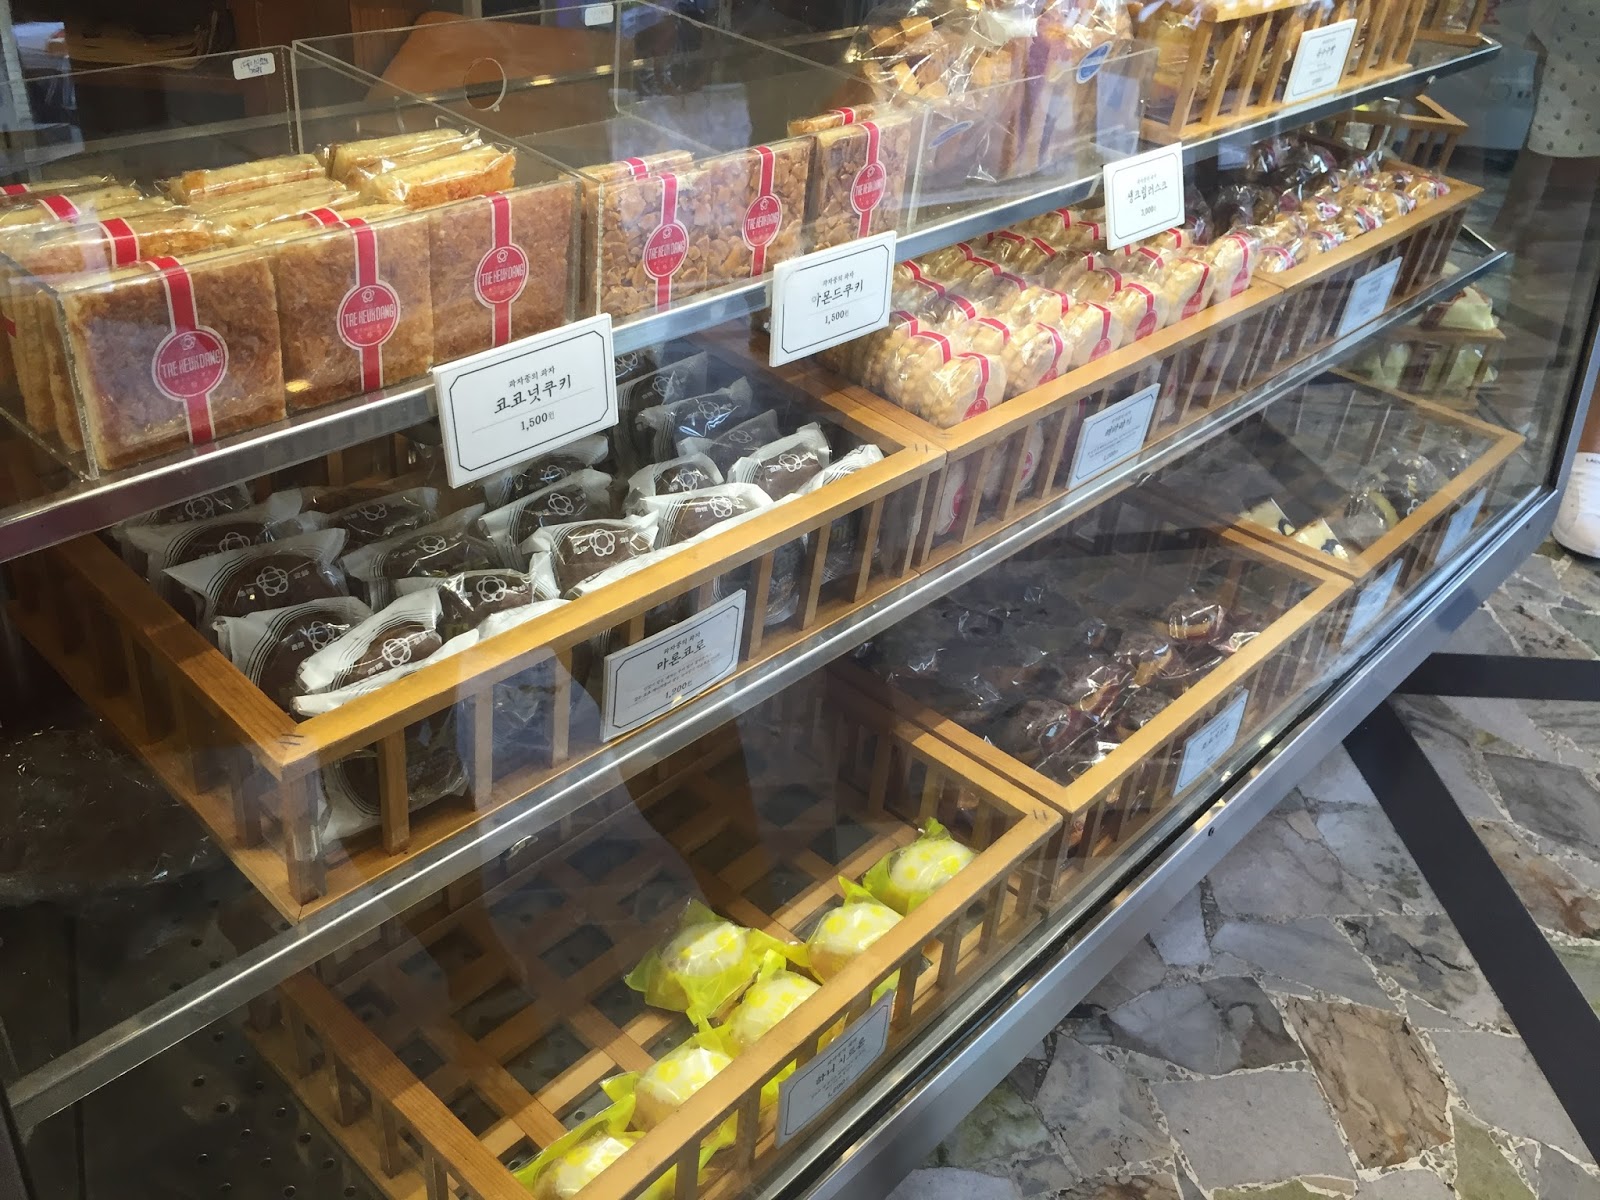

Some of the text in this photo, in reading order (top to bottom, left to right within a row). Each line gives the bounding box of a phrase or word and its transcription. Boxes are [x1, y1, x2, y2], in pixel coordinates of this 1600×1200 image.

[1127, 181, 1168, 204] 생크림러스크
[811, 279, 864, 308] 아몬드쿠키
[508, 365, 556, 389] 과자중의 과자
[494, 374, 571, 414] 코코넛쿠키
[521, 411, 555, 432] 1,500원
[657, 638, 706, 671] 마론코로
